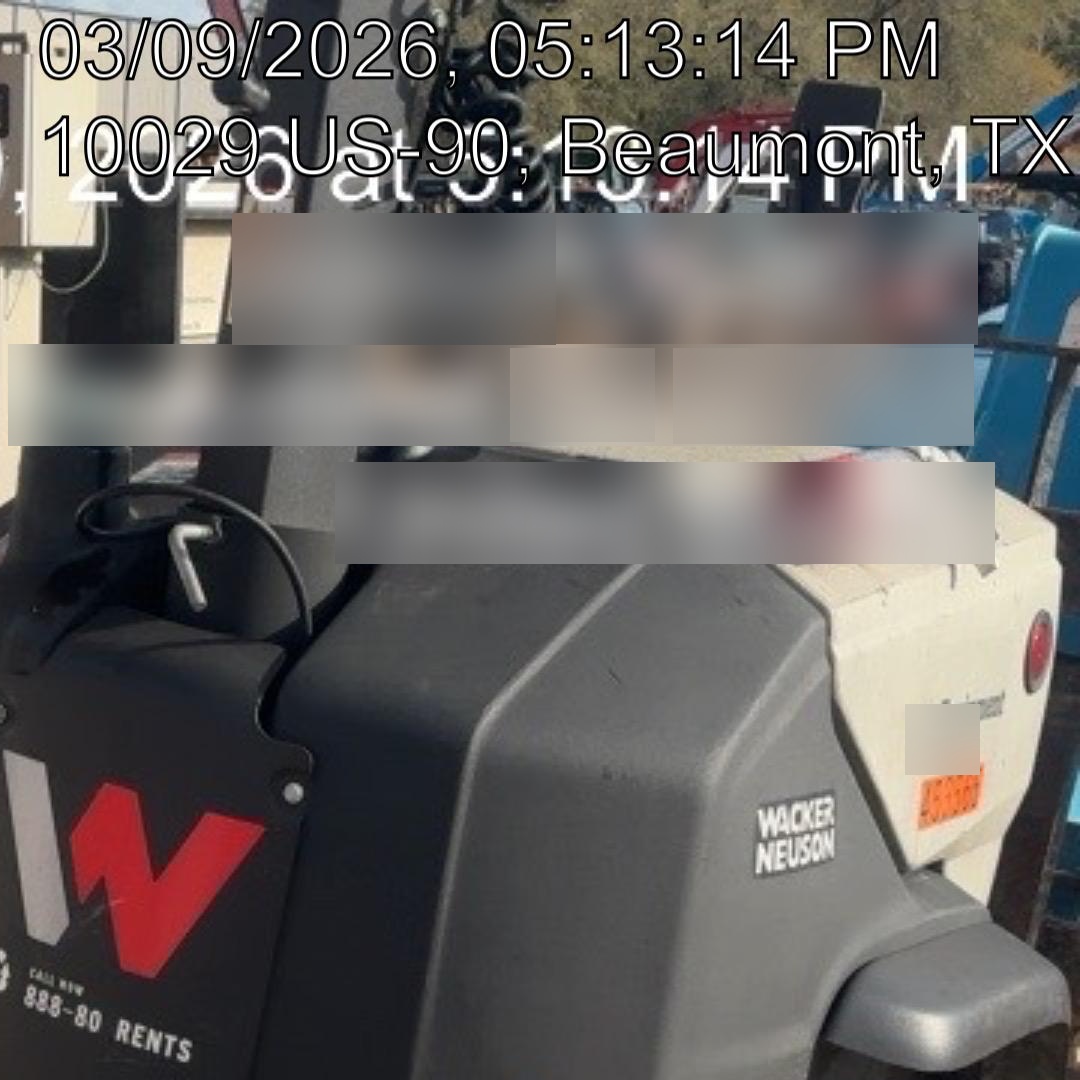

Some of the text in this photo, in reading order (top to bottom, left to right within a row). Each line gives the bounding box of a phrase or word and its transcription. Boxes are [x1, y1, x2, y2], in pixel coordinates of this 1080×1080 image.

[756, 795, 835, 838] WACKER
[755, 828, 835, 874] NEUSON
[29, 967, 85, 997] CALL NOW
[23, 983, 193, 1063] 888-80 RENTS
